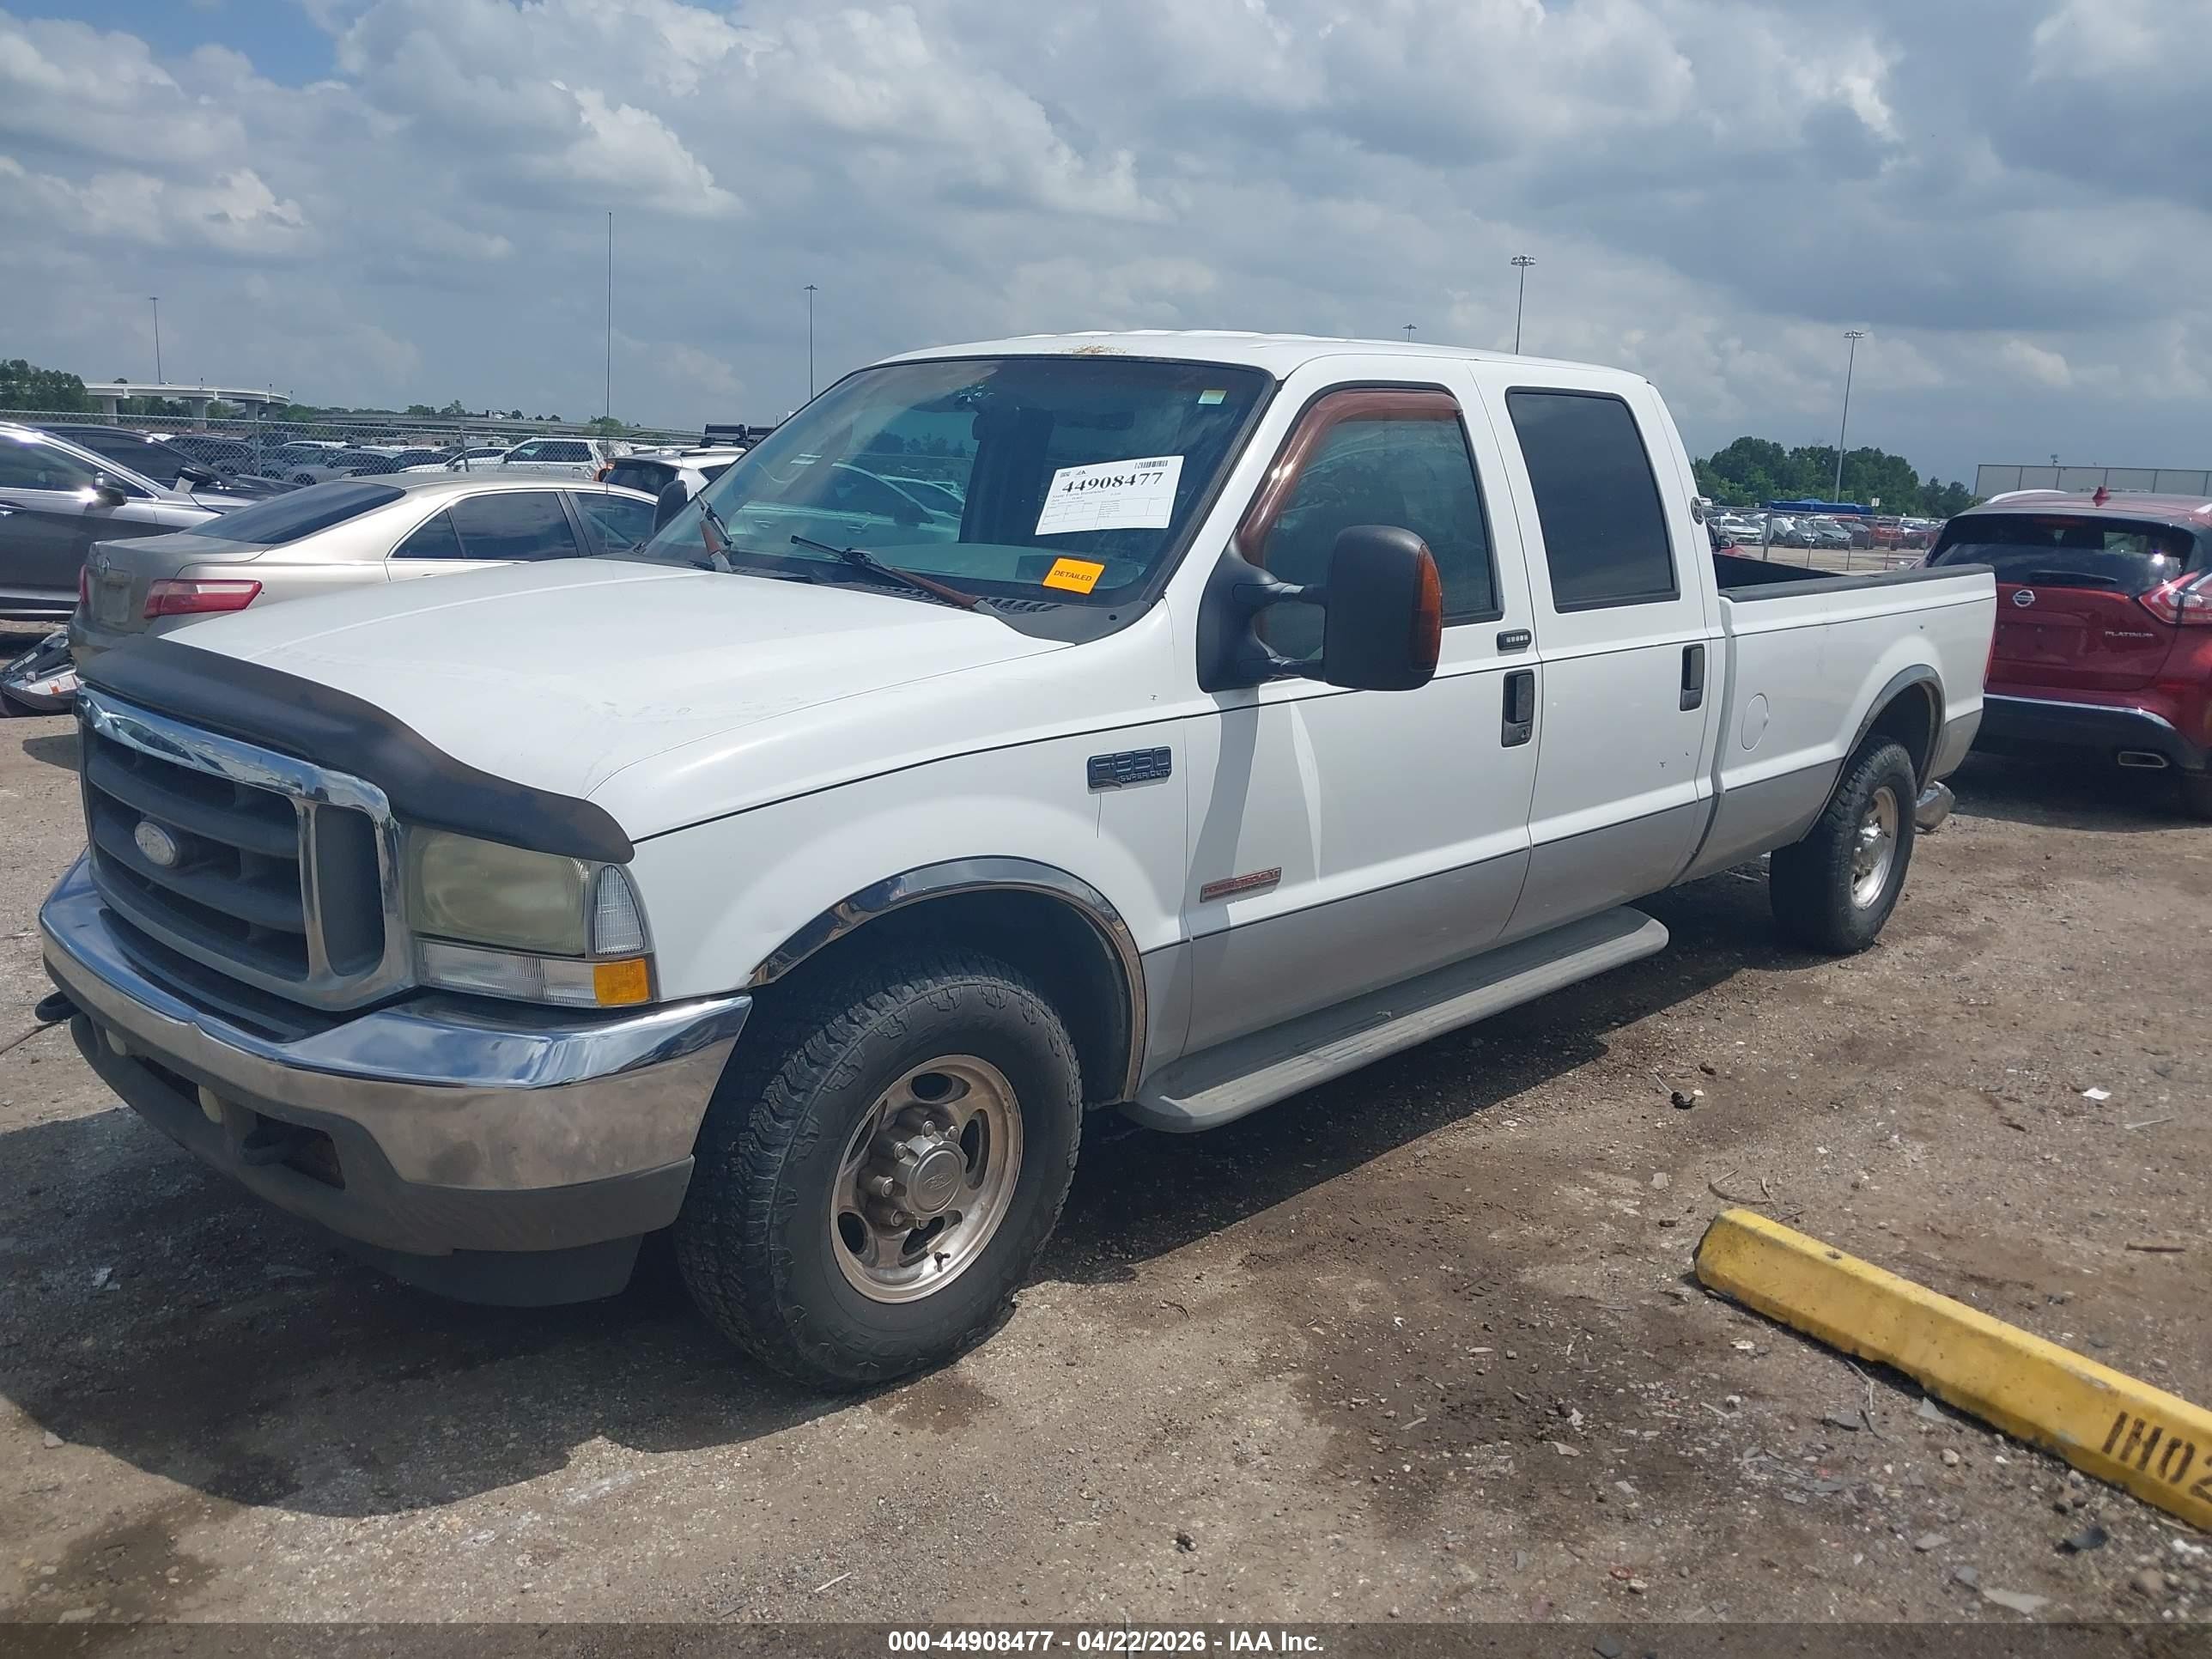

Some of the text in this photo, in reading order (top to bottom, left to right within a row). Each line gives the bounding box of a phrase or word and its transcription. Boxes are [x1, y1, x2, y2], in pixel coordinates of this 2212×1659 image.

[1061, 471, 1164, 494] 44908477
[1054, 569, 1092, 581] DETAILED
[1119, 768, 1171, 783] SUPER DUTY
